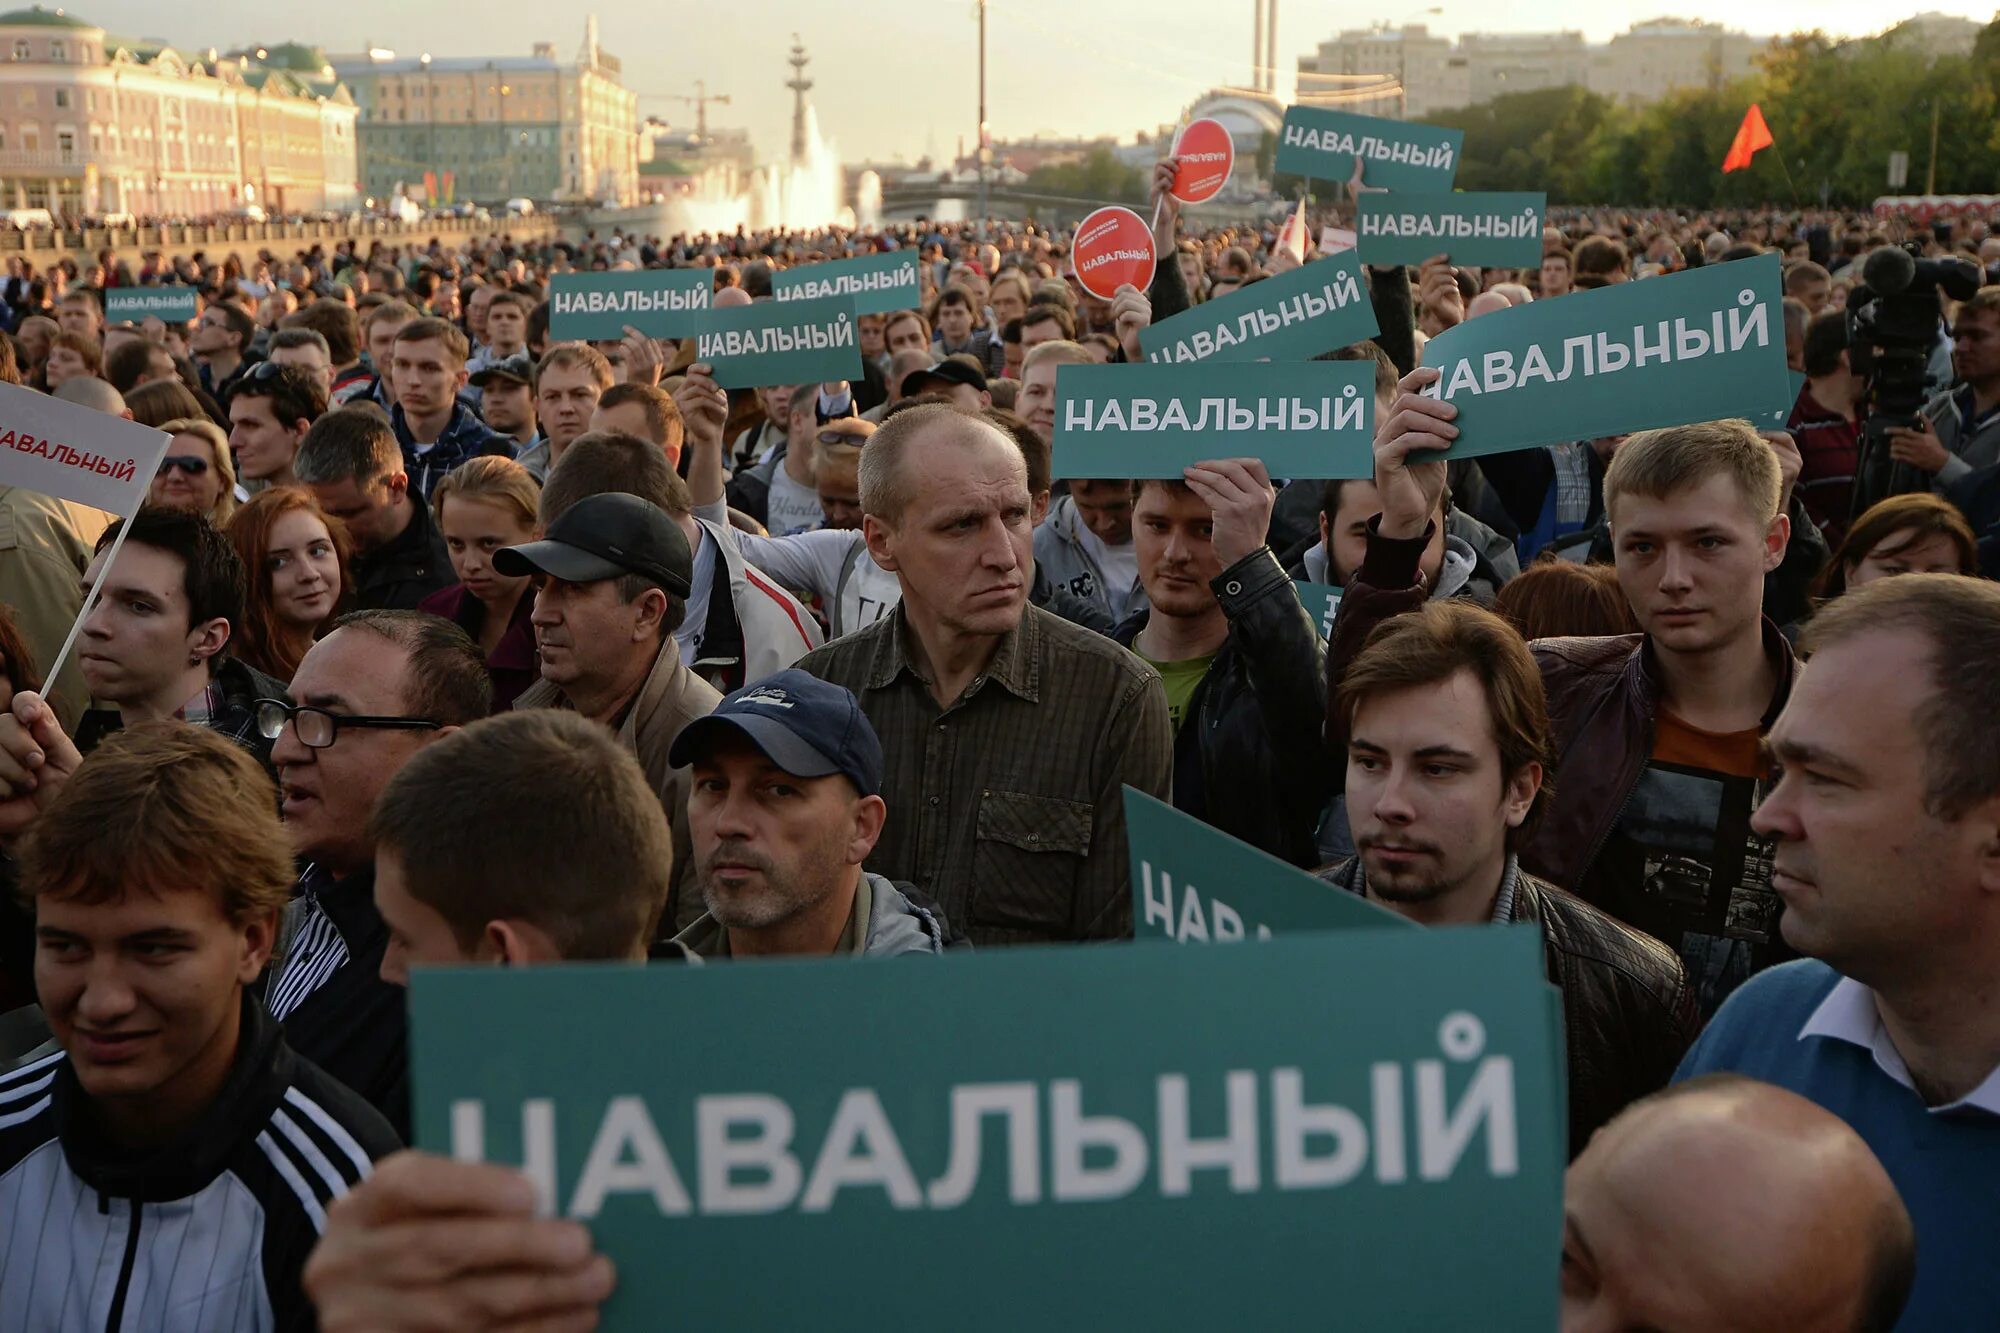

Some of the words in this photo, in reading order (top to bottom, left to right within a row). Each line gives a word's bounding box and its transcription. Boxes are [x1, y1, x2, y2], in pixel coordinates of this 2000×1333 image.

[1284, 124, 1454, 170] НАВАЛЬНЫЙ
[1362, 207, 1538, 238] НАВАЛЬНЫЙ
[1082, 248, 1151, 272] НАВАЛЬНЫЙ
[108, 292, 195, 310] НАВАЛЬНЫЙ
[555, 282, 709, 314] НАВАЛЬНЫЙ
[699, 313, 854, 359] НАВАЛЬНЫЙ
[1064, 384, 1365, 431] НАВАЛЬНЫЙ
[0, 426, 136, 482] АВАЛЬНЫЙ
